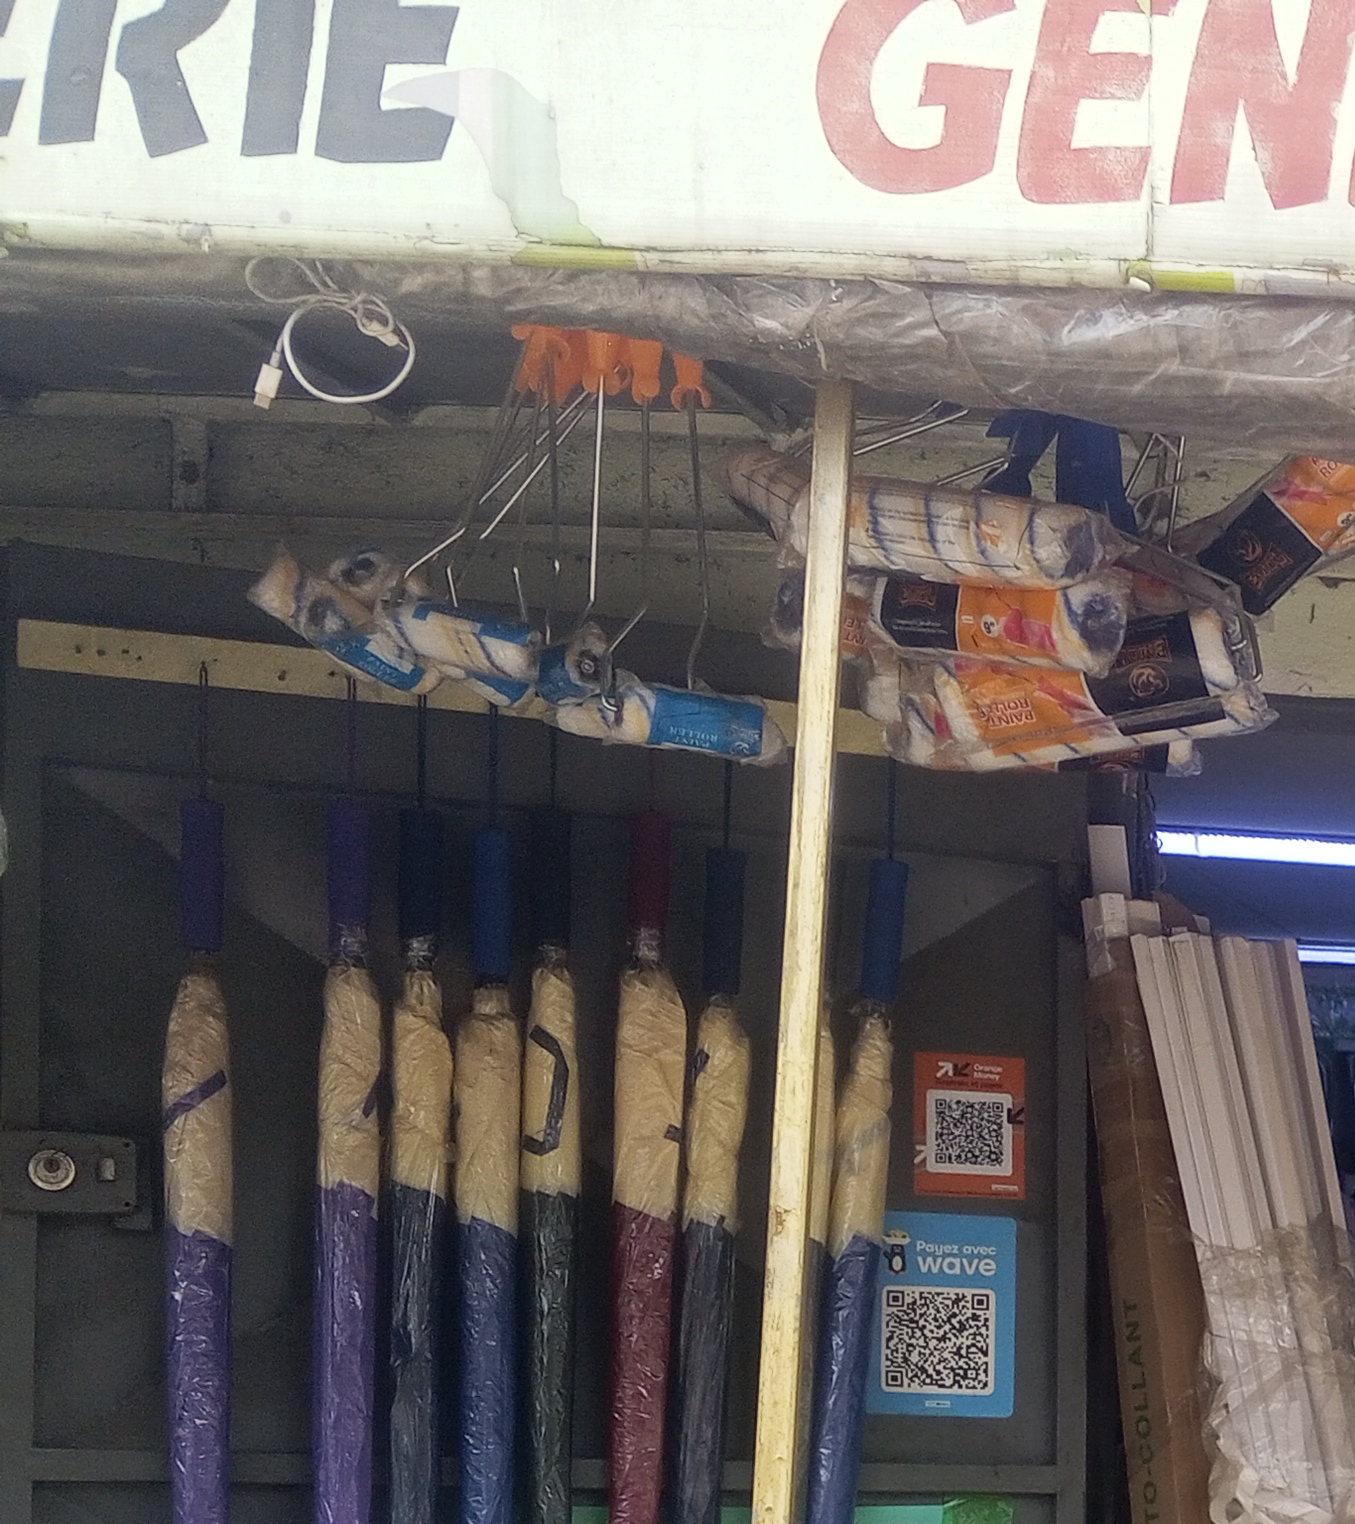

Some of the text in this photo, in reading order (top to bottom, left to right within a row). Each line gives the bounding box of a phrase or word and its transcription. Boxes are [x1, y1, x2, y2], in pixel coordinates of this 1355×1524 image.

[0, 0, 460, 163] RIE
[973, 1062, 1003, 1075] Orange
[973, 1072, 1001, 1082] Money
[916, 1240, 996, 1256] Payez avec
[916, 1256, 996, 1276] wave
